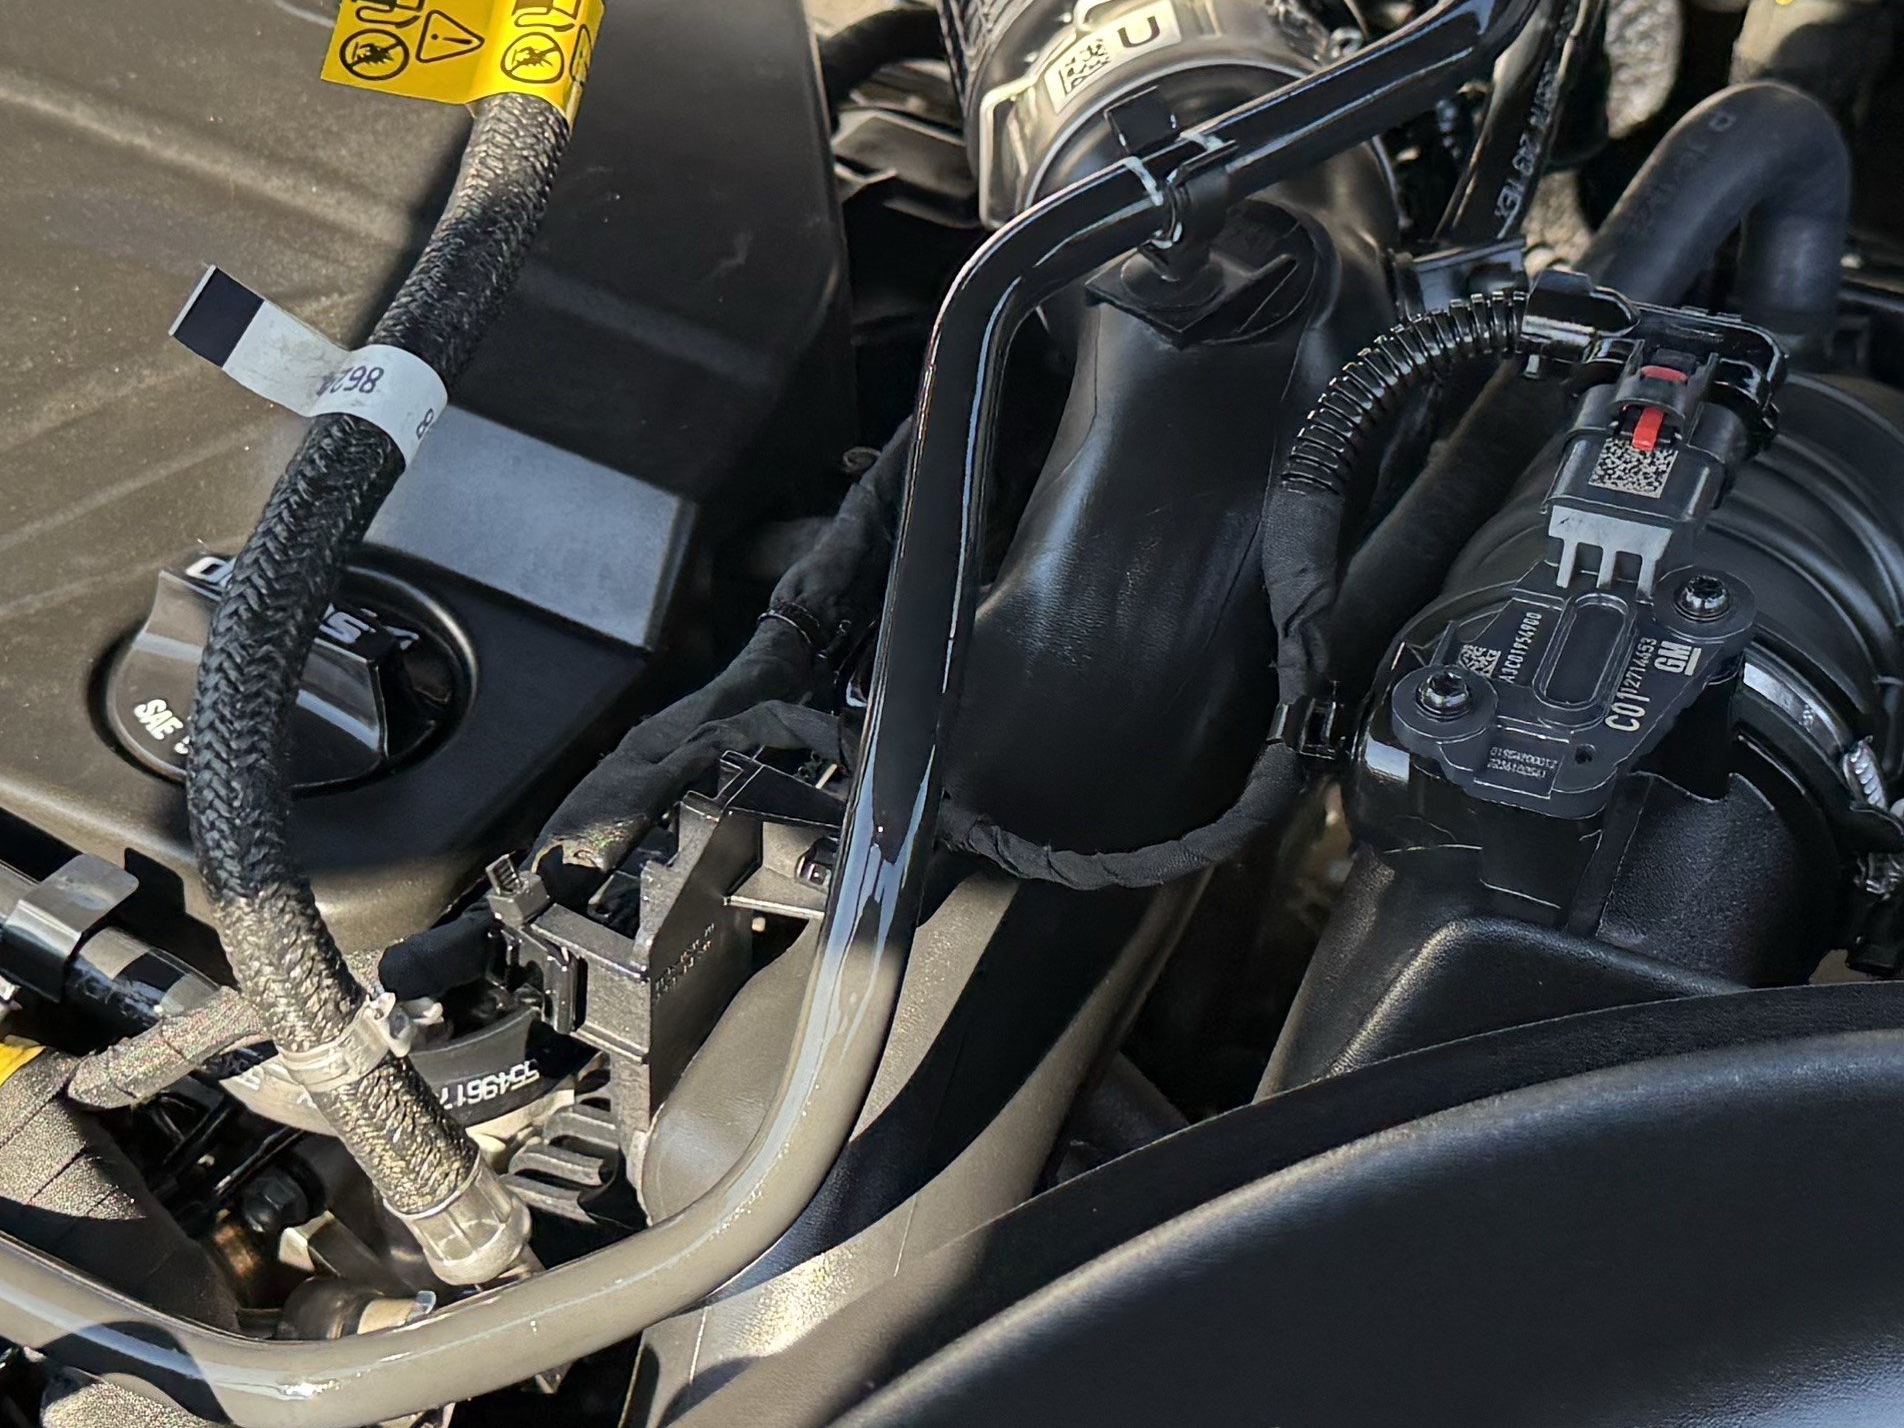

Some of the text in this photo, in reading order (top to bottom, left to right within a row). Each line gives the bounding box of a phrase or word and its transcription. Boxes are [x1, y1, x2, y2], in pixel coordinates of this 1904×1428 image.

[1117, 15, 1160, 48] U
[1654, 640, 1699, 675] GM
[134, 699, 184, 740] SAE
[438, 1058, 540, 1111] 5549617
